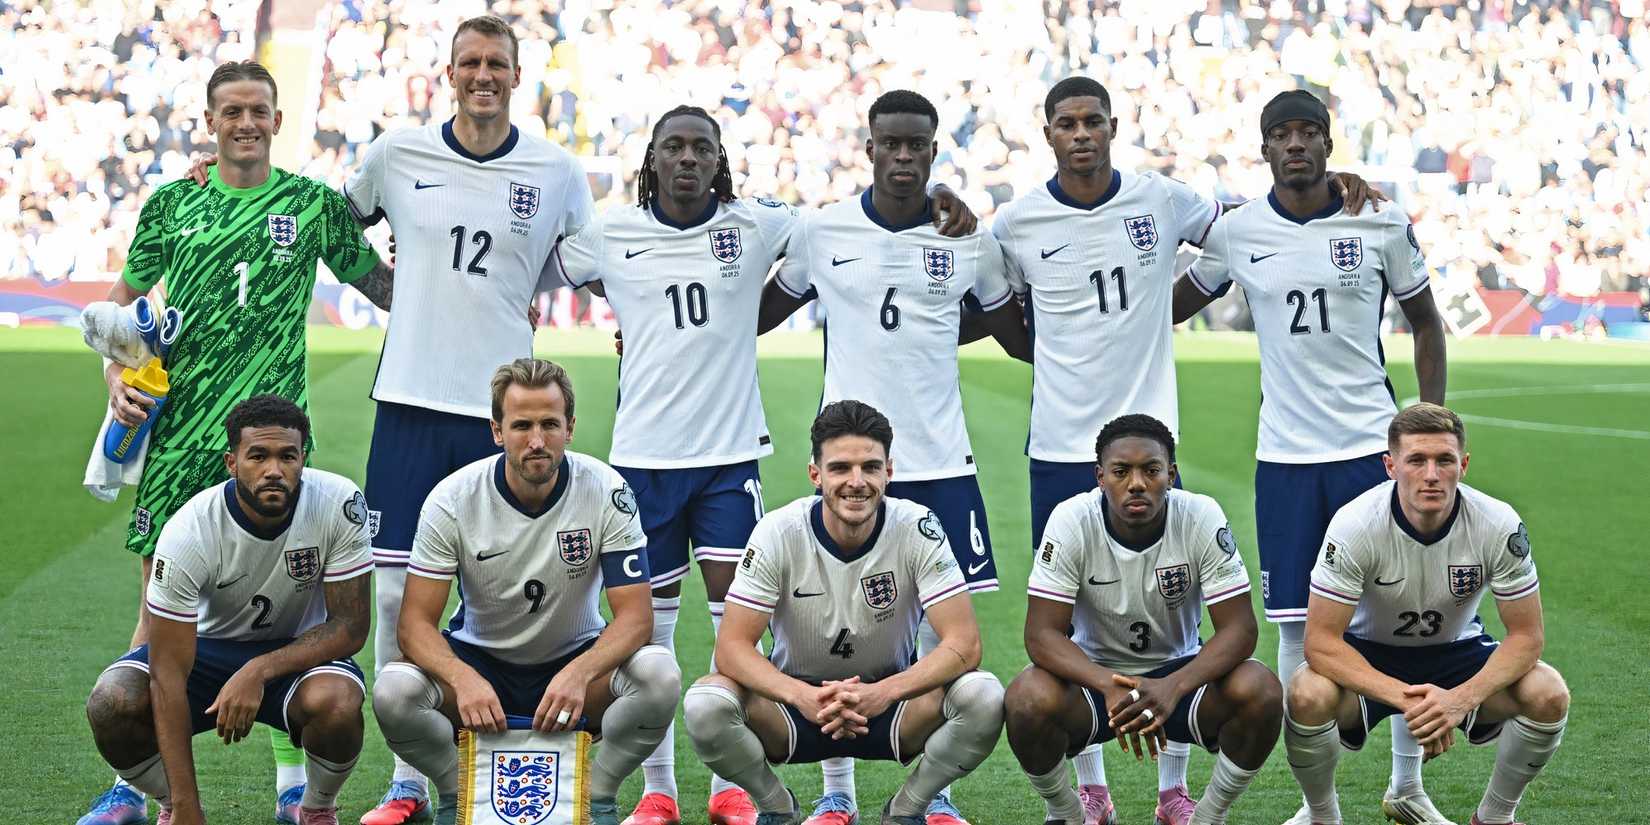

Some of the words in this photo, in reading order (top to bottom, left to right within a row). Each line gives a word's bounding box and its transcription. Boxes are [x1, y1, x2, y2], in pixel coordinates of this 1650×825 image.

[451, 225, 493, 277] 12
[233, 261, 250, 307] 1
[664, 282, 709, 329] 10
[1089, 266, 1129, 314] 11
[880, 287, 901, 332] 6
[1286, 288, 1331, 335] 21
[970, 510, 985, 555] 6
[622, 554, 642, 578] C
[251, 594, 273, 631] 2
[524, 579, 546, 614] 9
[830, 628, 855, 659] 4
[1129, 621, 1151, 653] 3
[1393, 609, 1445, 638] 23
